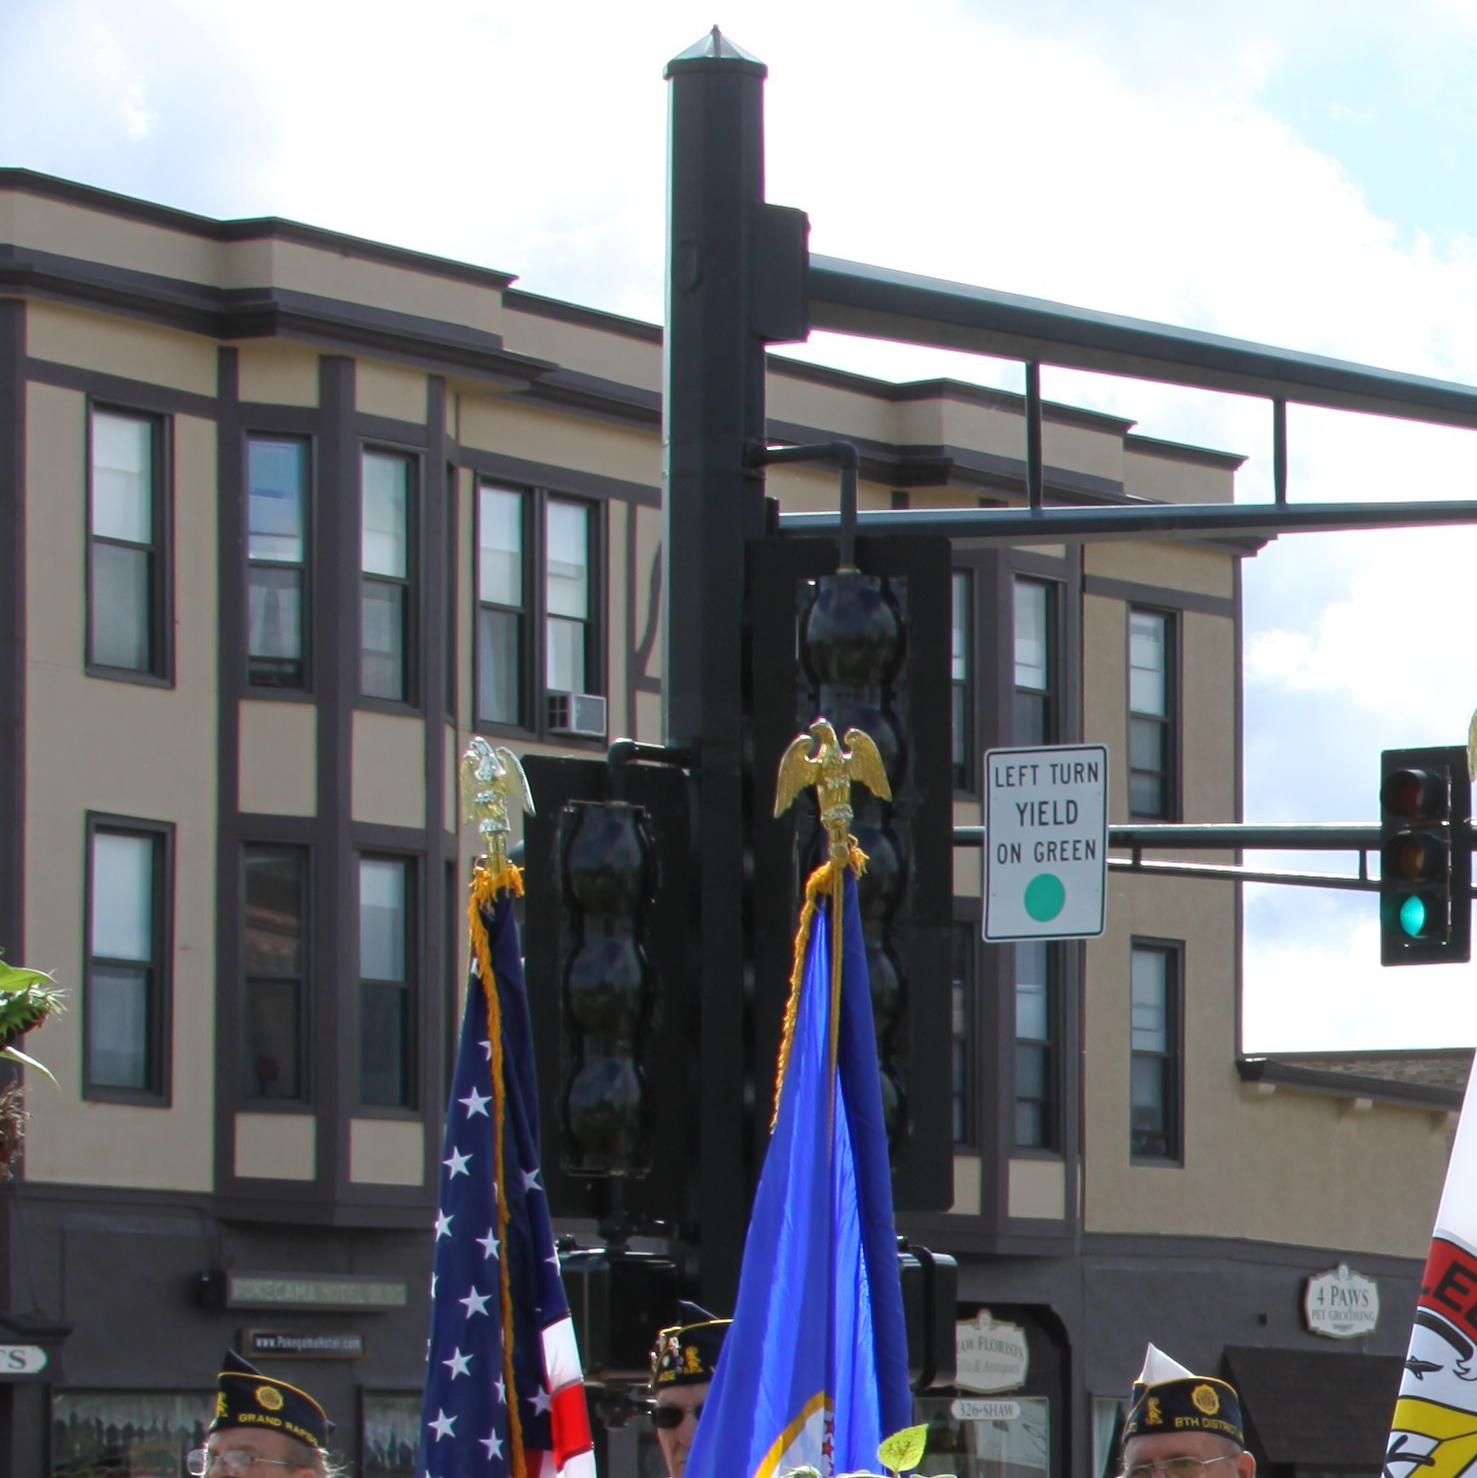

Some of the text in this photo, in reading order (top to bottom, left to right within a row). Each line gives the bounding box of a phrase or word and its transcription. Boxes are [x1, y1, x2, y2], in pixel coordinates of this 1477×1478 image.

[995, 762, 1098, 787] LEFT TURN
[1015, 800, 1078, 827] YIELD
[997, 839, 1096, 864] ON GREEN
[1317, 1285, 1369, 1308] 4 PAWS
[1311, 1309, 1326, 1320] PET
[239, 1413, 282, 1427] GRAND
